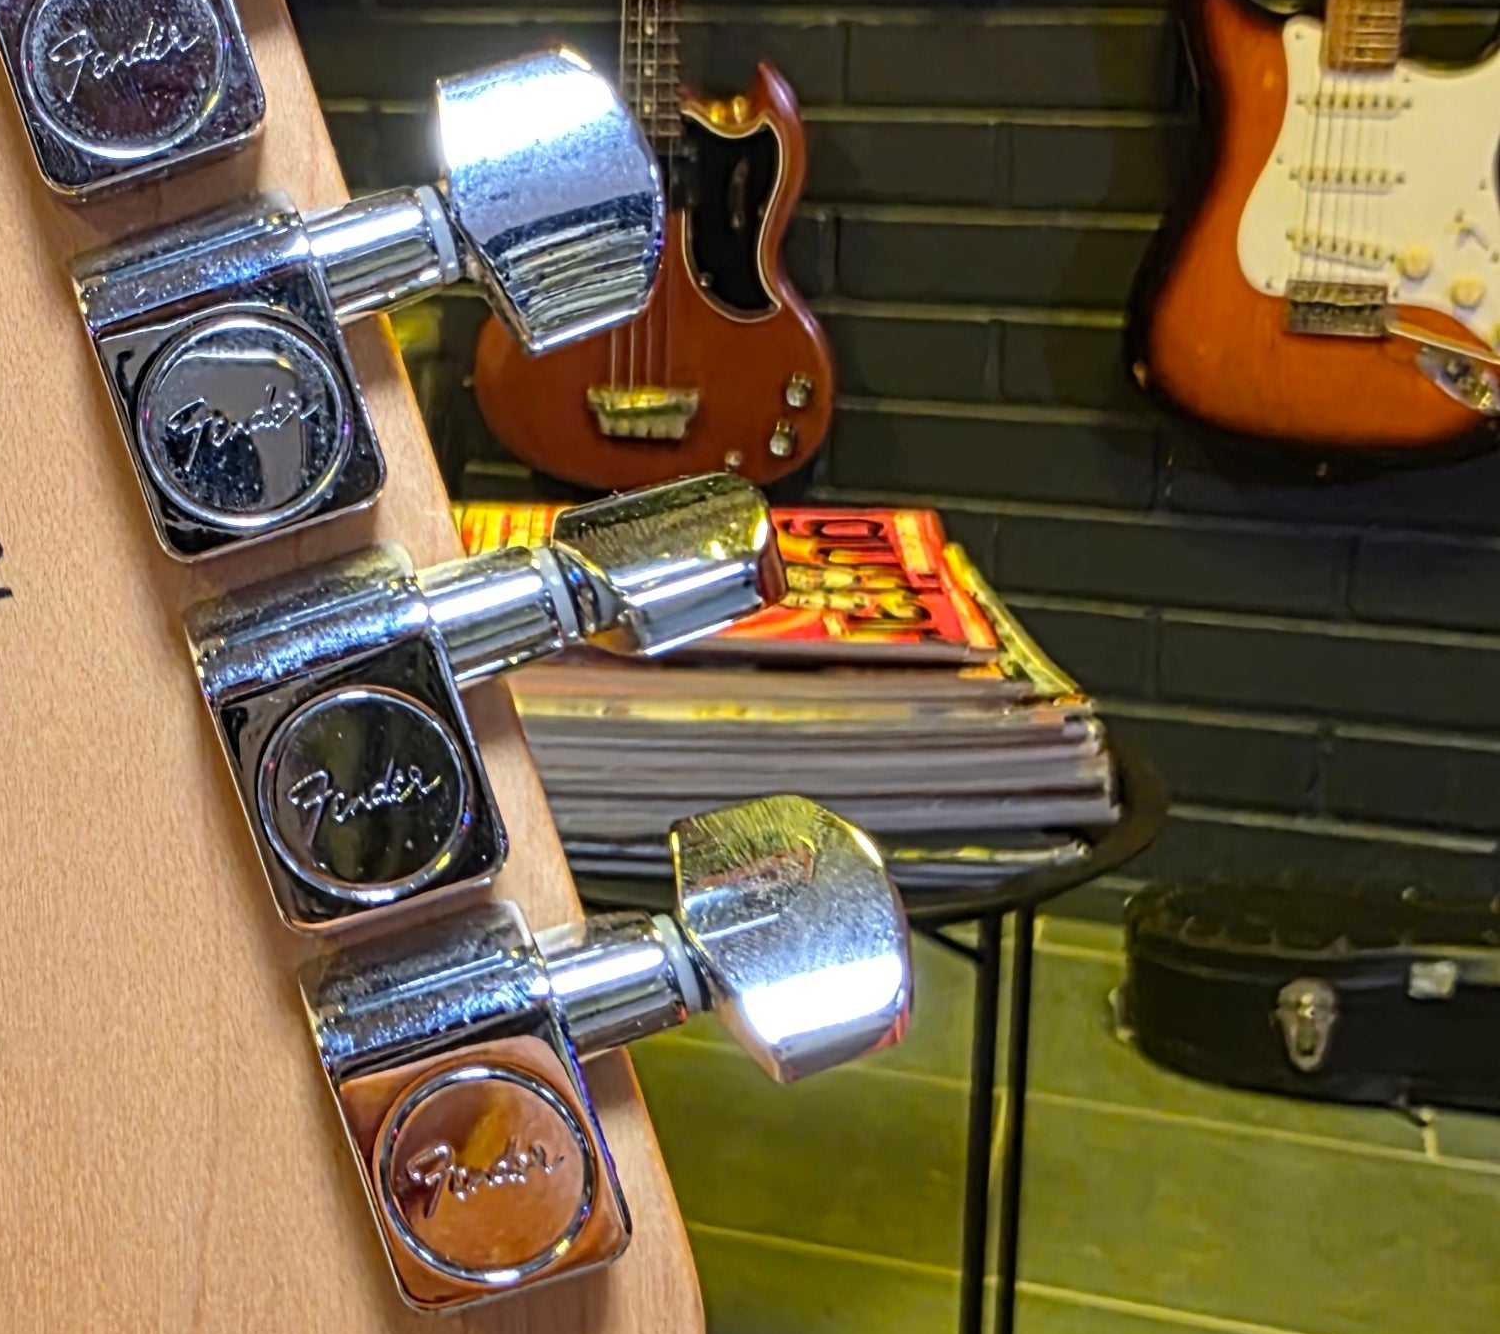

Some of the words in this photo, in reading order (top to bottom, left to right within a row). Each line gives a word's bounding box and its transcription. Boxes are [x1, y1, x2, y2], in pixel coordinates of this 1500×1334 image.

[49, 18, 201, 104] Fender
[166, 383, 320, 471] Fender
[288, 756, 442, 849] Fender
[407, 1134, 565, 1219] Fender
